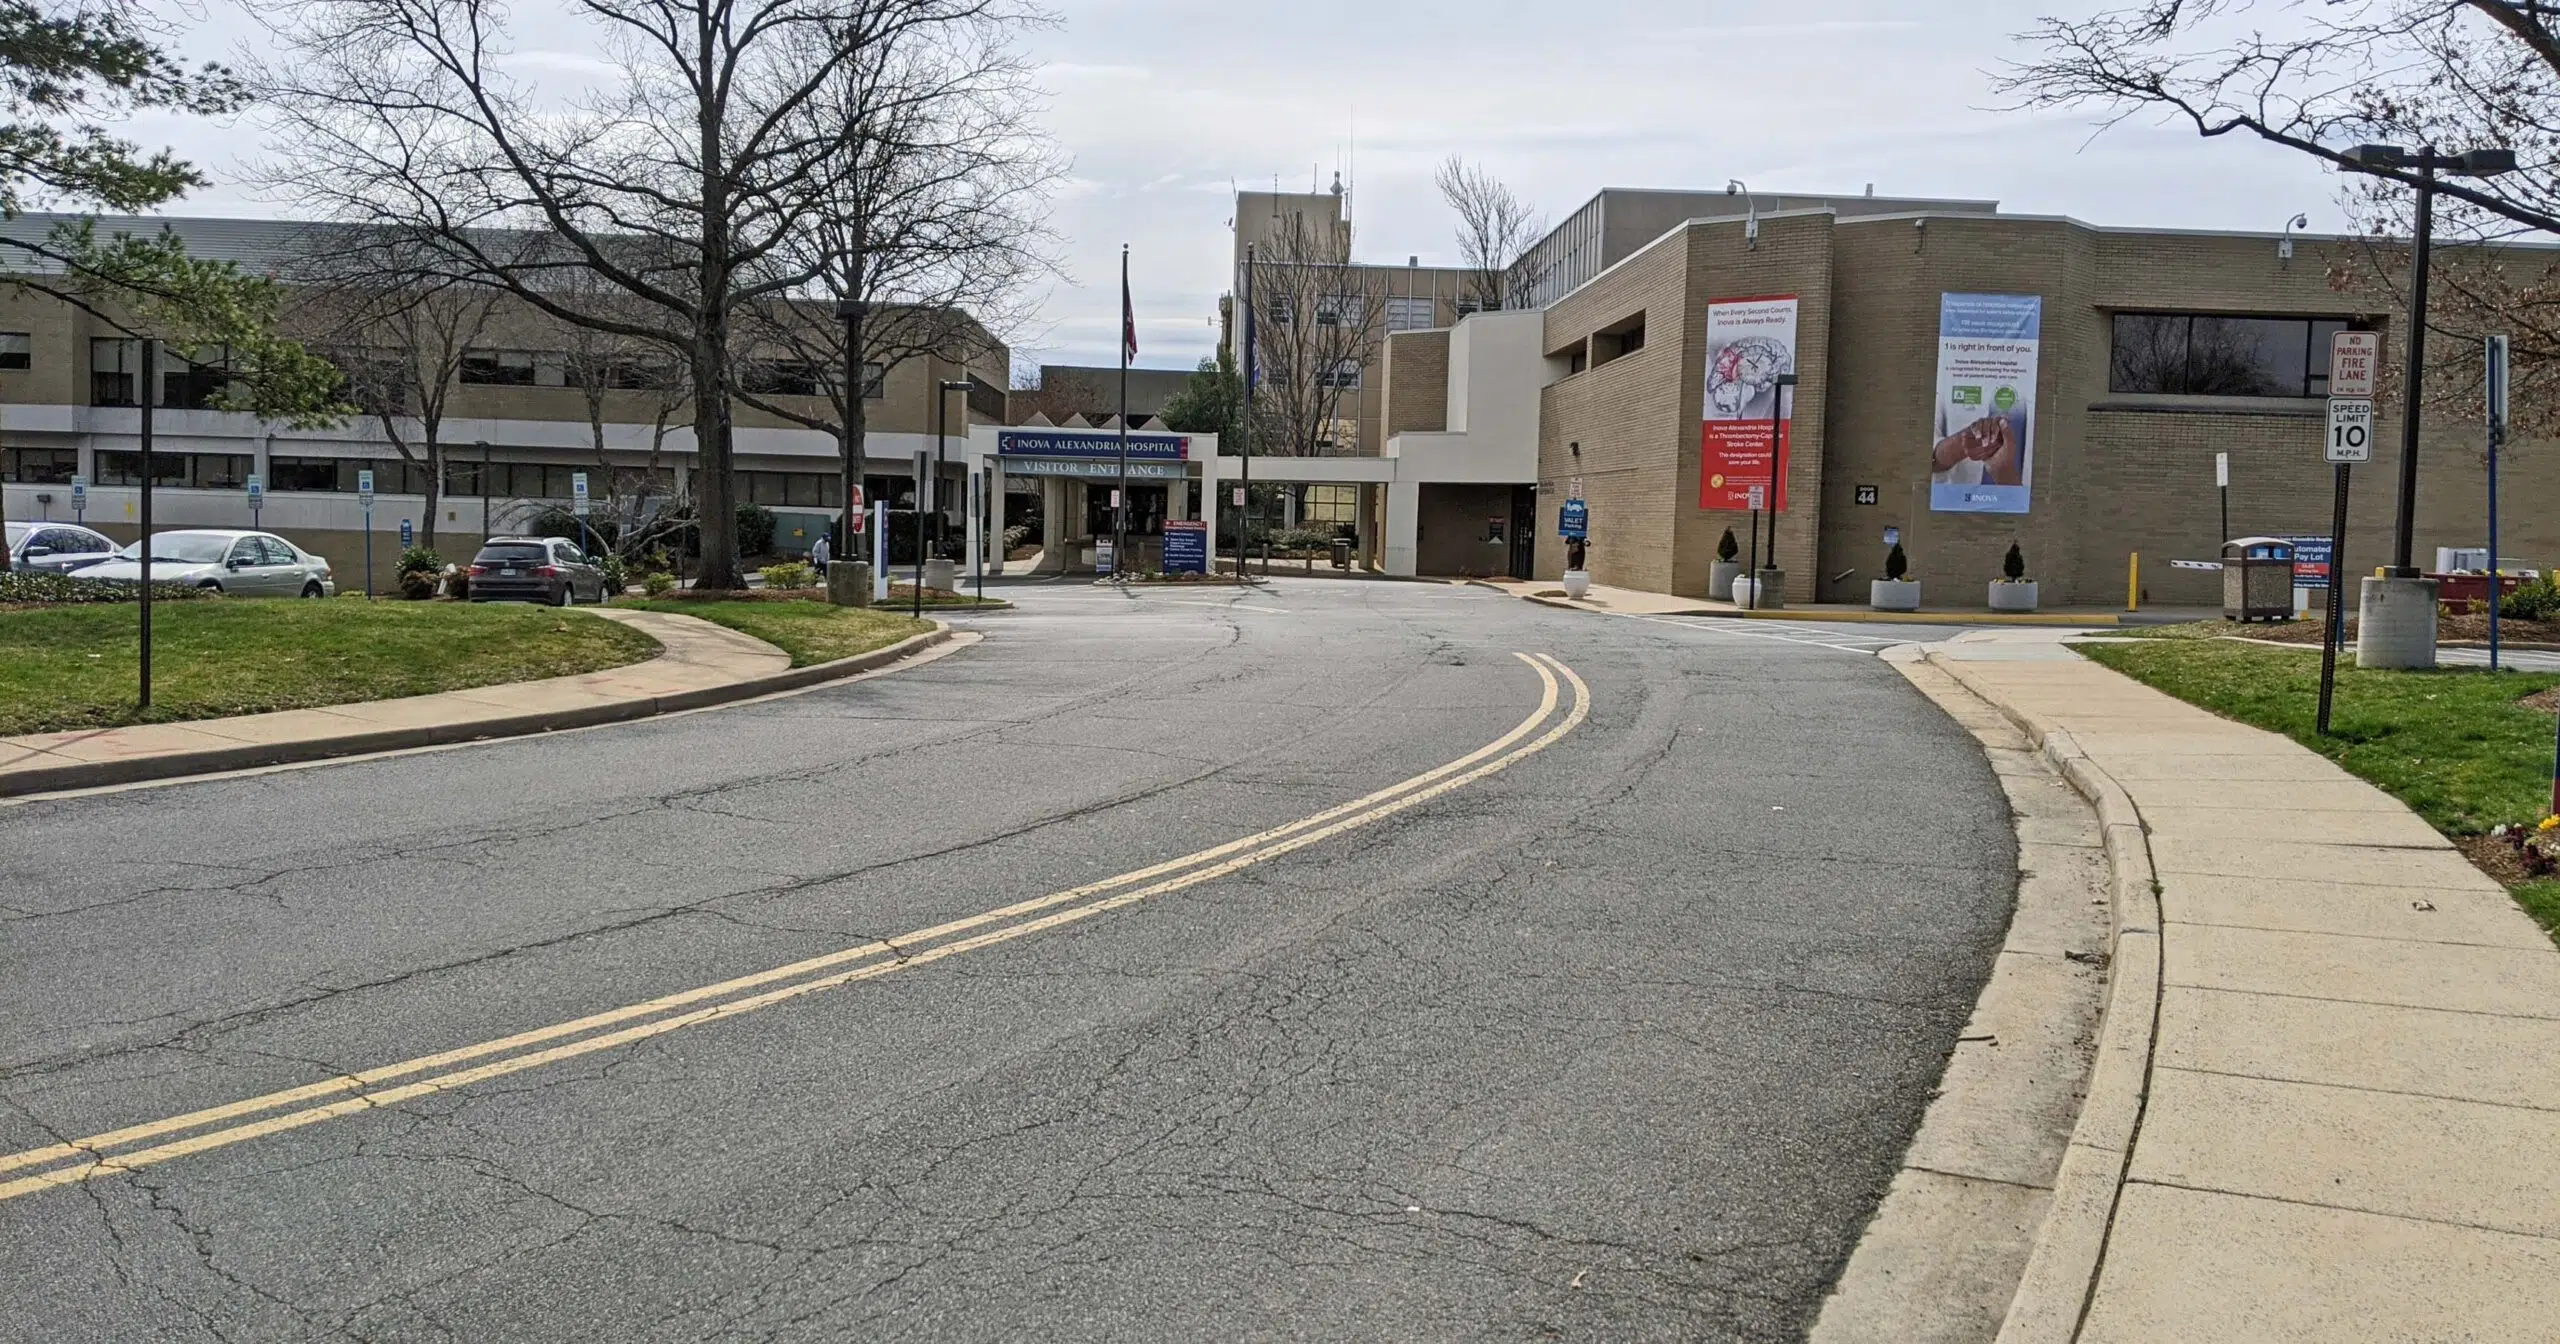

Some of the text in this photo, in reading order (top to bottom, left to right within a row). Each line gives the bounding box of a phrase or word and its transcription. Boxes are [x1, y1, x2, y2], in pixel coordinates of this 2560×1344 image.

[2349, 336, 2361, 345] NO
[1958, 343, 1976, 353] right
[1987, 344, 2005, 352] front
[2336, 347, 2372, 356] PARKING
[2342, 358, 2366, 369] FIRE
[2339, 370, 2366, 381] LANE
[2332, 404, 2370, 413] SPEED
[2336, 414, 2366, 423] LIMIT
[2334, 425, 2365, 447] 10
[1018, 439, 1050, 449] INOVA
[1055, 440, 1120, 451] ALEXANDRIA
[1126, 441, 1175, 452] HOSPITAL
[1024, 461, 1165, 476] VISITOR ENTANCE
[1858, 491, 1875, 504] 44
[2294, 553, 2324, 562] Pay Lot
